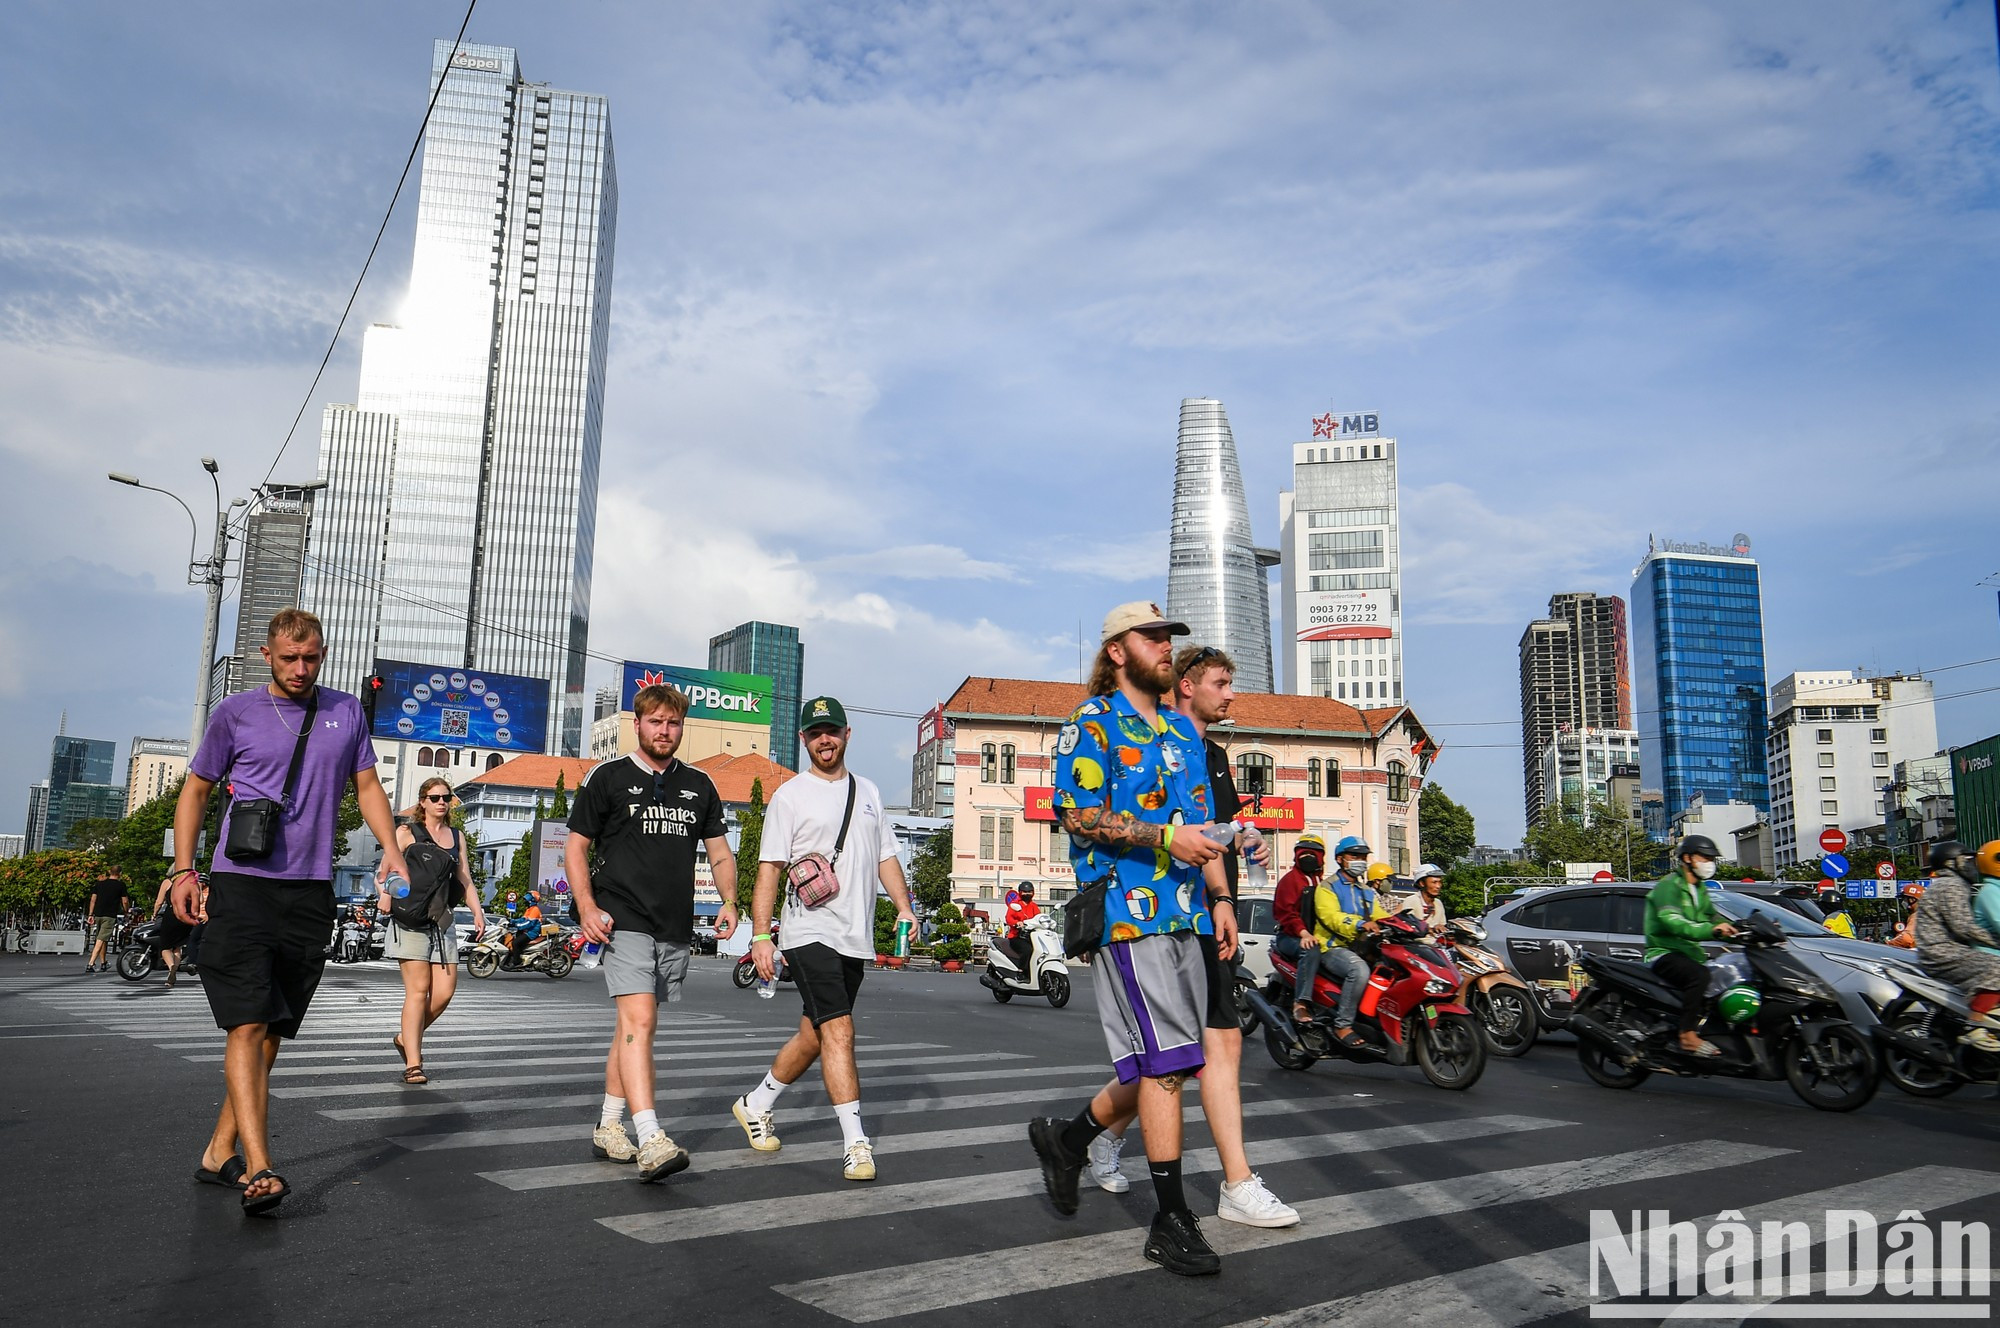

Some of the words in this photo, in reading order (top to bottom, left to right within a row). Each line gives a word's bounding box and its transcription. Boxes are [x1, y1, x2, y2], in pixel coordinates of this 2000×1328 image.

[451, 54, 498, 69] Keppel
[1342, 414, 1379, 434] MB
[266, 499, 300, 510] Keppel
[1310, 605, 1334, 614] 0903
[1336, 604, 1349, 613] 79
[1351, 604, 1362, 612] 77
[1365, 603, 1377, 612] 99
[1310, 615, 1334, 623] 0906
[1336, 614, 1349, 622] 68
[1351, 614, 1363, 622] 22
[1365, 613, 1377, 621] 22
[446, 692, 468, 702] VTV
[675, 684, 761, 713] VPBank
[1036, 796, 1053, 810] CHỦ
[1260, 806, 1284, 819] CHÚNG
[1284, 808, 1294, 819] TA
[643, 820, 659, 834] FLY
